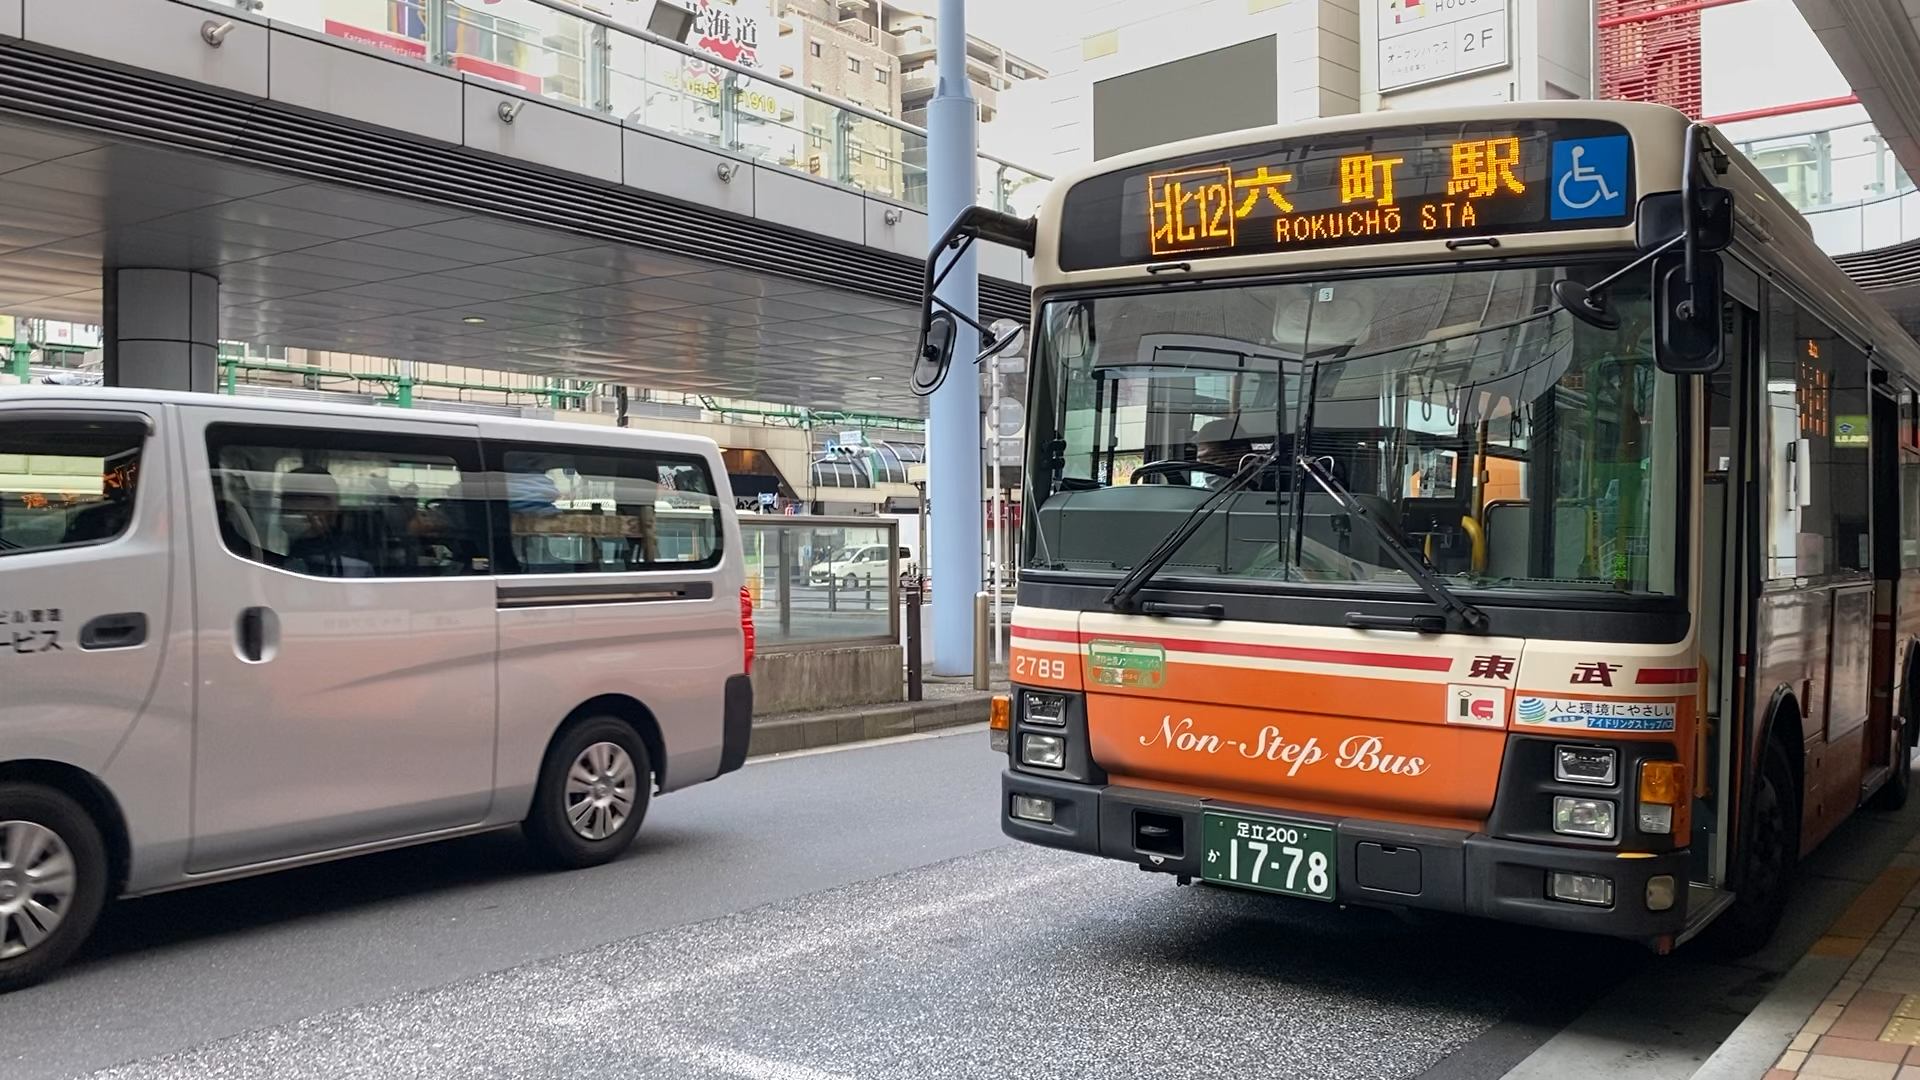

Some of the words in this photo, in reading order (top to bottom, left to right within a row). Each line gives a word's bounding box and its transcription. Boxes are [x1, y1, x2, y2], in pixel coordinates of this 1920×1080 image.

[342, 31, 377, 46] Karaoke
[1463, 28, 1493, 52] 2F
[1155, 182, 1229, 244] 北12
[1421, 201, 1476, 230] STA
[1016, 655, 1065, 680] 2789
[1550, 700, 1675, 717] 人と環境にやさしい
[1139, 715, 1328, 776] Non-Step
[1335, 735, 1431, 776] Bus
[1207, 849, 1220, 863] か
[1230, 839, 1329, 894] 17-78
